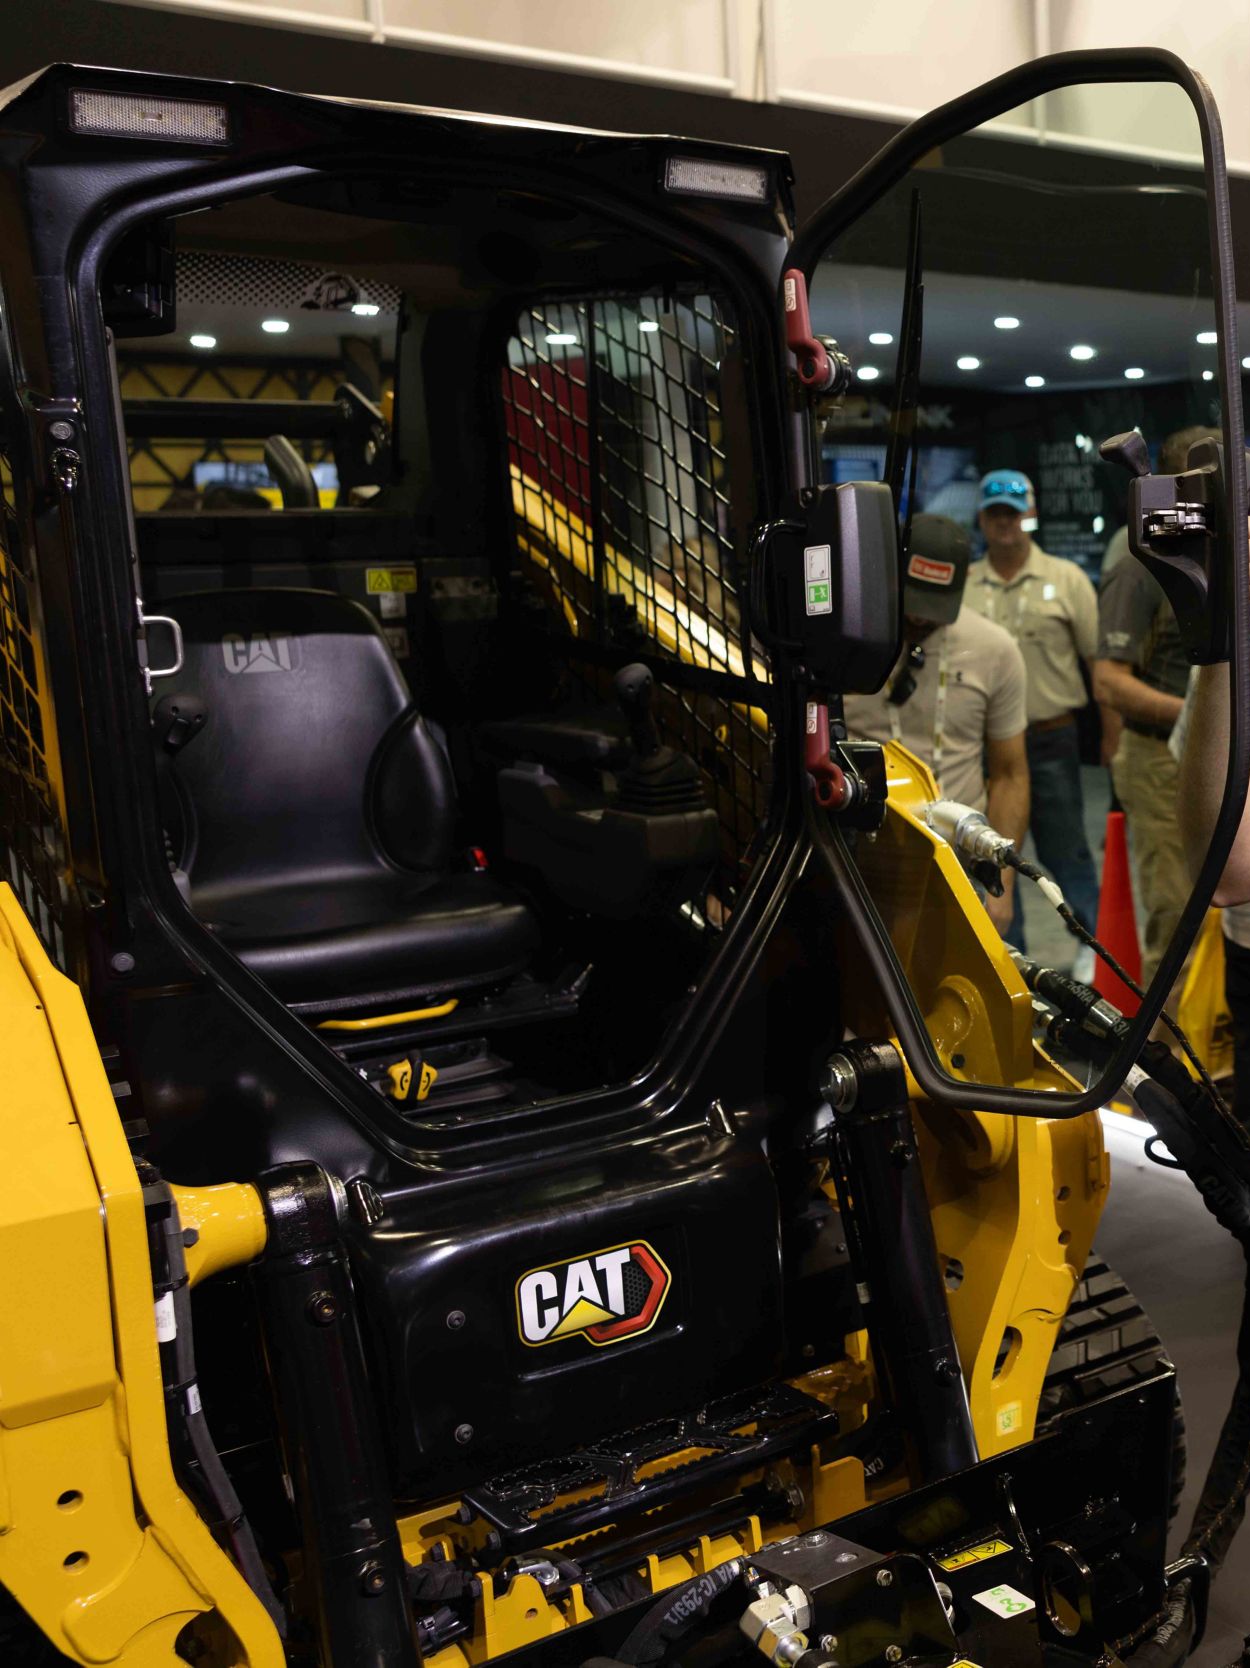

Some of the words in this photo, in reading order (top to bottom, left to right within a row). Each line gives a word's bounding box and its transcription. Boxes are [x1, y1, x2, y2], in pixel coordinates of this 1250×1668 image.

[222, 633, 291, 674] CAT
[520, 1247, 631, 1342] CAT
[663, 1574, 718, 1625] IC-293/1
